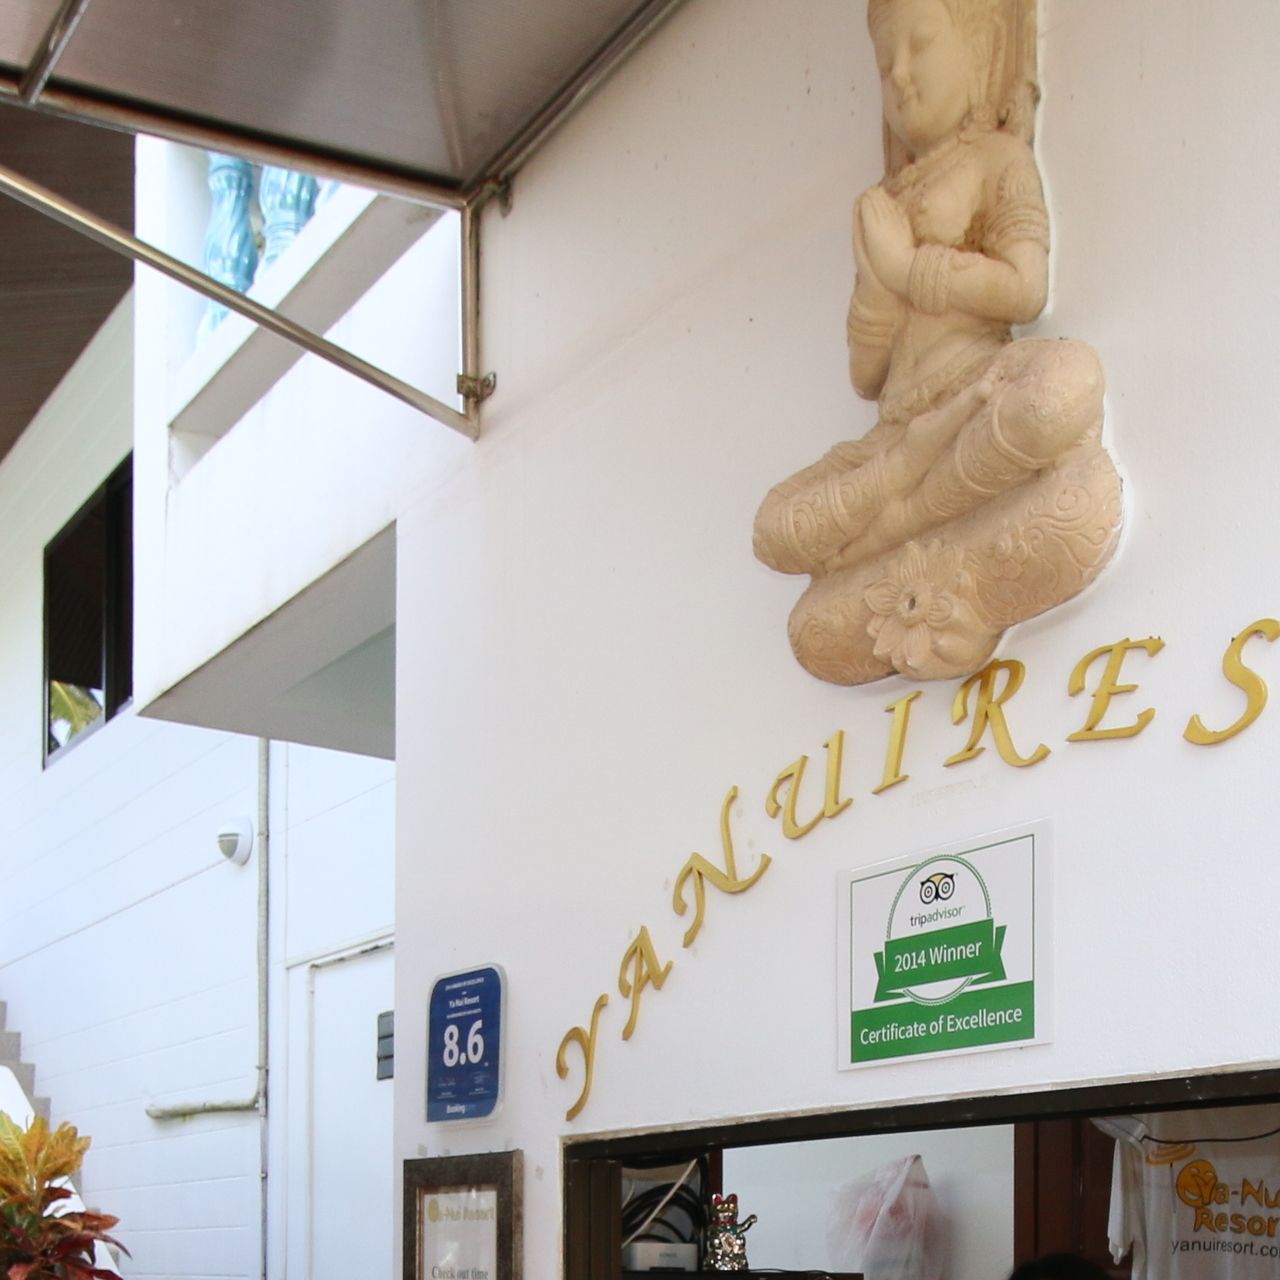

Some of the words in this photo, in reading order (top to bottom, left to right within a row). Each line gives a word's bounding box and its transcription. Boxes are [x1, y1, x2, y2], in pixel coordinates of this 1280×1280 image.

[910, 905, 964, 928] tripadvisor
[894, 950, 926, 973] 2014
[929, 940, 982, 965] Winner
[860, 1020, 927, 1046] Certificate
[929, 1014, 944, 1036] of
[947, 1006, 1023, 1033] Excellence
[443, 1019, 485, 1068] 8.6
[431, 1265, 456, 1280] Check
[456, 1268, 470, 1280] out
[471, 1267, 489, 1280] time
